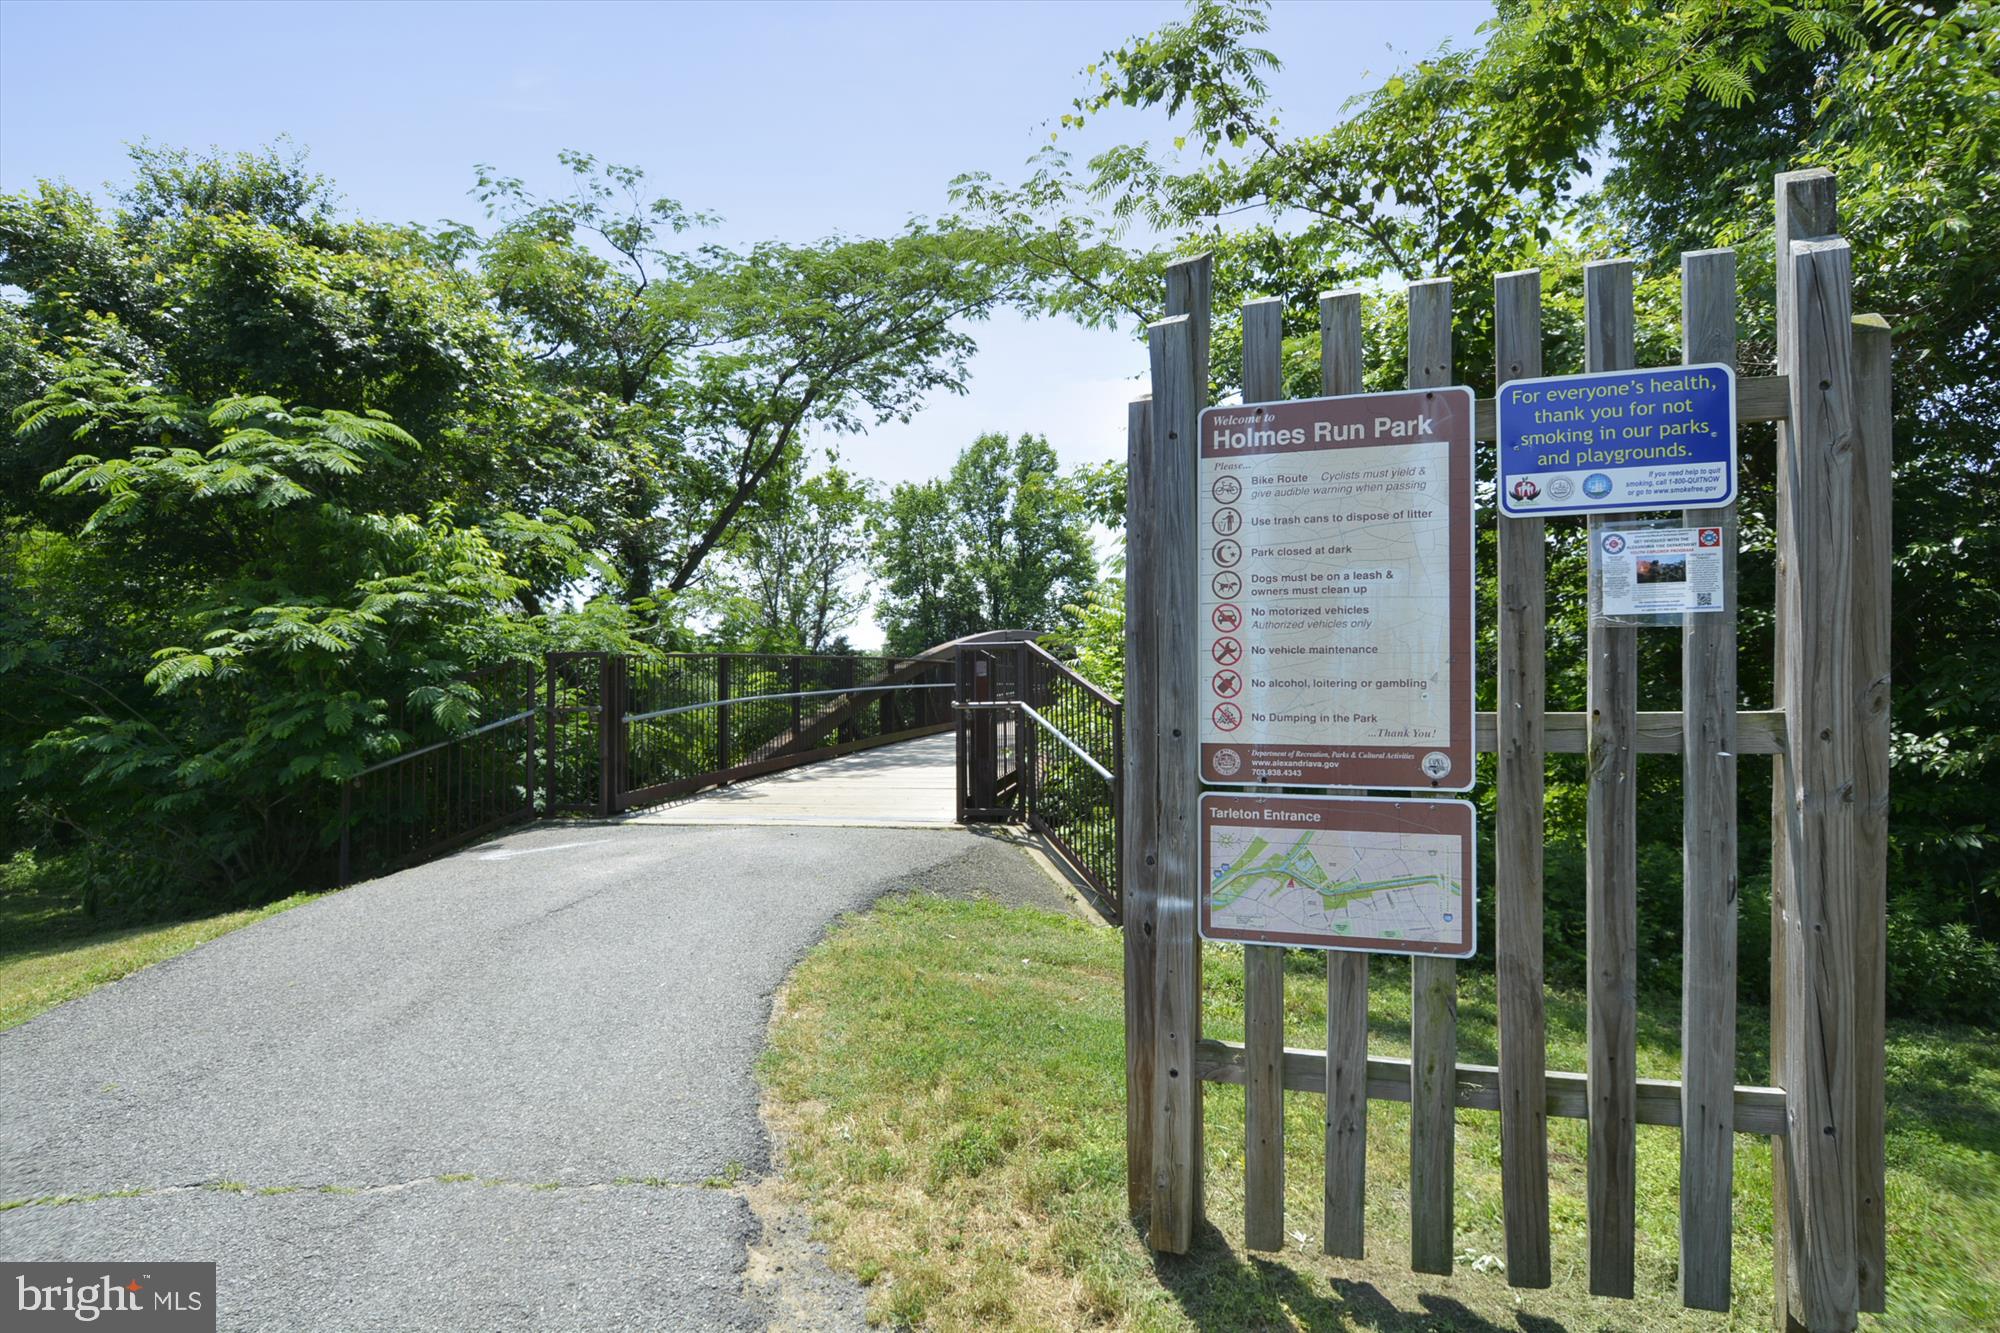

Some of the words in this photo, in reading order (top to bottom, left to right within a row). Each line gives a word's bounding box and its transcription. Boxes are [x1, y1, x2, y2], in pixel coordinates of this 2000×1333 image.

[1512, 391, 1540, 404] For
[1650, 375, 1716, 393] health,
[1534, 407, 1584, 423] thank
[1591, 405, 1623, 422] you
[1629, 402, 1655, 415] for
[1663, 400, 1693, 413] not
[1213, 414, 1261, 426] Welcome
[1264, 414, 1275, 422] to
[1213, 428, 1305, 449] Holmes
[1314, 422, 1364, 442] Run
[1375, 415, 1433, 438] Park
[1521, 427, 1593, 445] smoking
[1600, 426, 1615, 440] in
[1622, 426, 1653, 438] our
[1660, 420, 1709, 438] parks
[1537, 451, 1569, 465] and
[1576, 443, 1693, 466] playgrounds.
[1251, 475, 1273, 485] Bike
[1277, 473, 1308, 483] Route
[1321, 471, 1360, 482] Cyclists
[1363, 470, 1388, 479] must
[1391, 467, 1414, 478] yield
[1417, 467, 1426, 475] &
[1656, 470, 1667, 478] you
[1668, 469, 1683, 477] need
[1685, 469, 1699, 477] help
[1708, 467, 1721, 475] quit
[1251, 489, 1272, 500] give
[1274, 487, 1310, 497] audible
[1313, 485, 1352, 496] warning
[1355, 483, 1382, 492] when
[1385, 481, 1426, 492] passing
[1251, 518, 1271, 526] Use
[1274, 514, 1300, 525] trash
[1303, 514, 1329, 523] cans
[1332, 514, 1343, 522] to
[1346, 511, 1389, 522] dispose
[1393, 510, 1404, 519] of
[1407, 510, 1432, 519] litter
[1251, 548, 1274, 557] Park
[1277, 546, 1312, 556] closed
[1315, 547, 1328, 555] at
[1331, 545, 1352, 554] dark
[1251, 574, 1278, 585] Dogs
[1281, 574, 1307, 582] must
[1310, 573, 1323, 582] be
[1326, 573, 1340, 581] on
[1353, 571, 1382, 580] leash
[1386, 571, 1393, 579] &
[1251, 586, 1288, 596] owners
[1292, 586, 1318, 595] must
[1321, 585, 1350, 594] clean
[1353, 585, 1367, 595] up
[1251, 607, 1265, 616] No
[1269, 606, 1322, 616] motorized
[1325, 605, 1369, 615] vehicles
[1251, 620, 1304, 630] Authorized
[1307, 620, 1347, 629] vehicles
[1350, 619, 1372, 630] only
[1251, 646, 1265, 655] No
[1269, 645, 1306, 654] vehicle
[1309, 645, 1378, 654] maintenance
[1251, 679, 1265, 688] No
[1269, 679, 1310, 689] alcohol,
[1313, 679, 1357, 689] loitering
[1361, 680, 1373, 688] or
[1376, 679, 1427, 689] gambling
[1251, 713, 1265, 722] No
[1269, 713, 1316, 724] Dumping
[1320, 714, 1329, 722] in
[1332, 714, 1350, 722] the
[1353, 714, 1378, 722] Park
[1413, 729, 1437, 738] You!
[1251, 750, 1286, 759] Department
[1287, 751, 1295, 759] of
[1332, 751, 1348, 759] Parks
[1385, 752, 1415, 760] Activities
[1251, 759, 1339, 768] www.alexandriava.gov
[1210, 808, 1260, 820] Tarleton
[1264, 809, 1321, 822] Entrance
